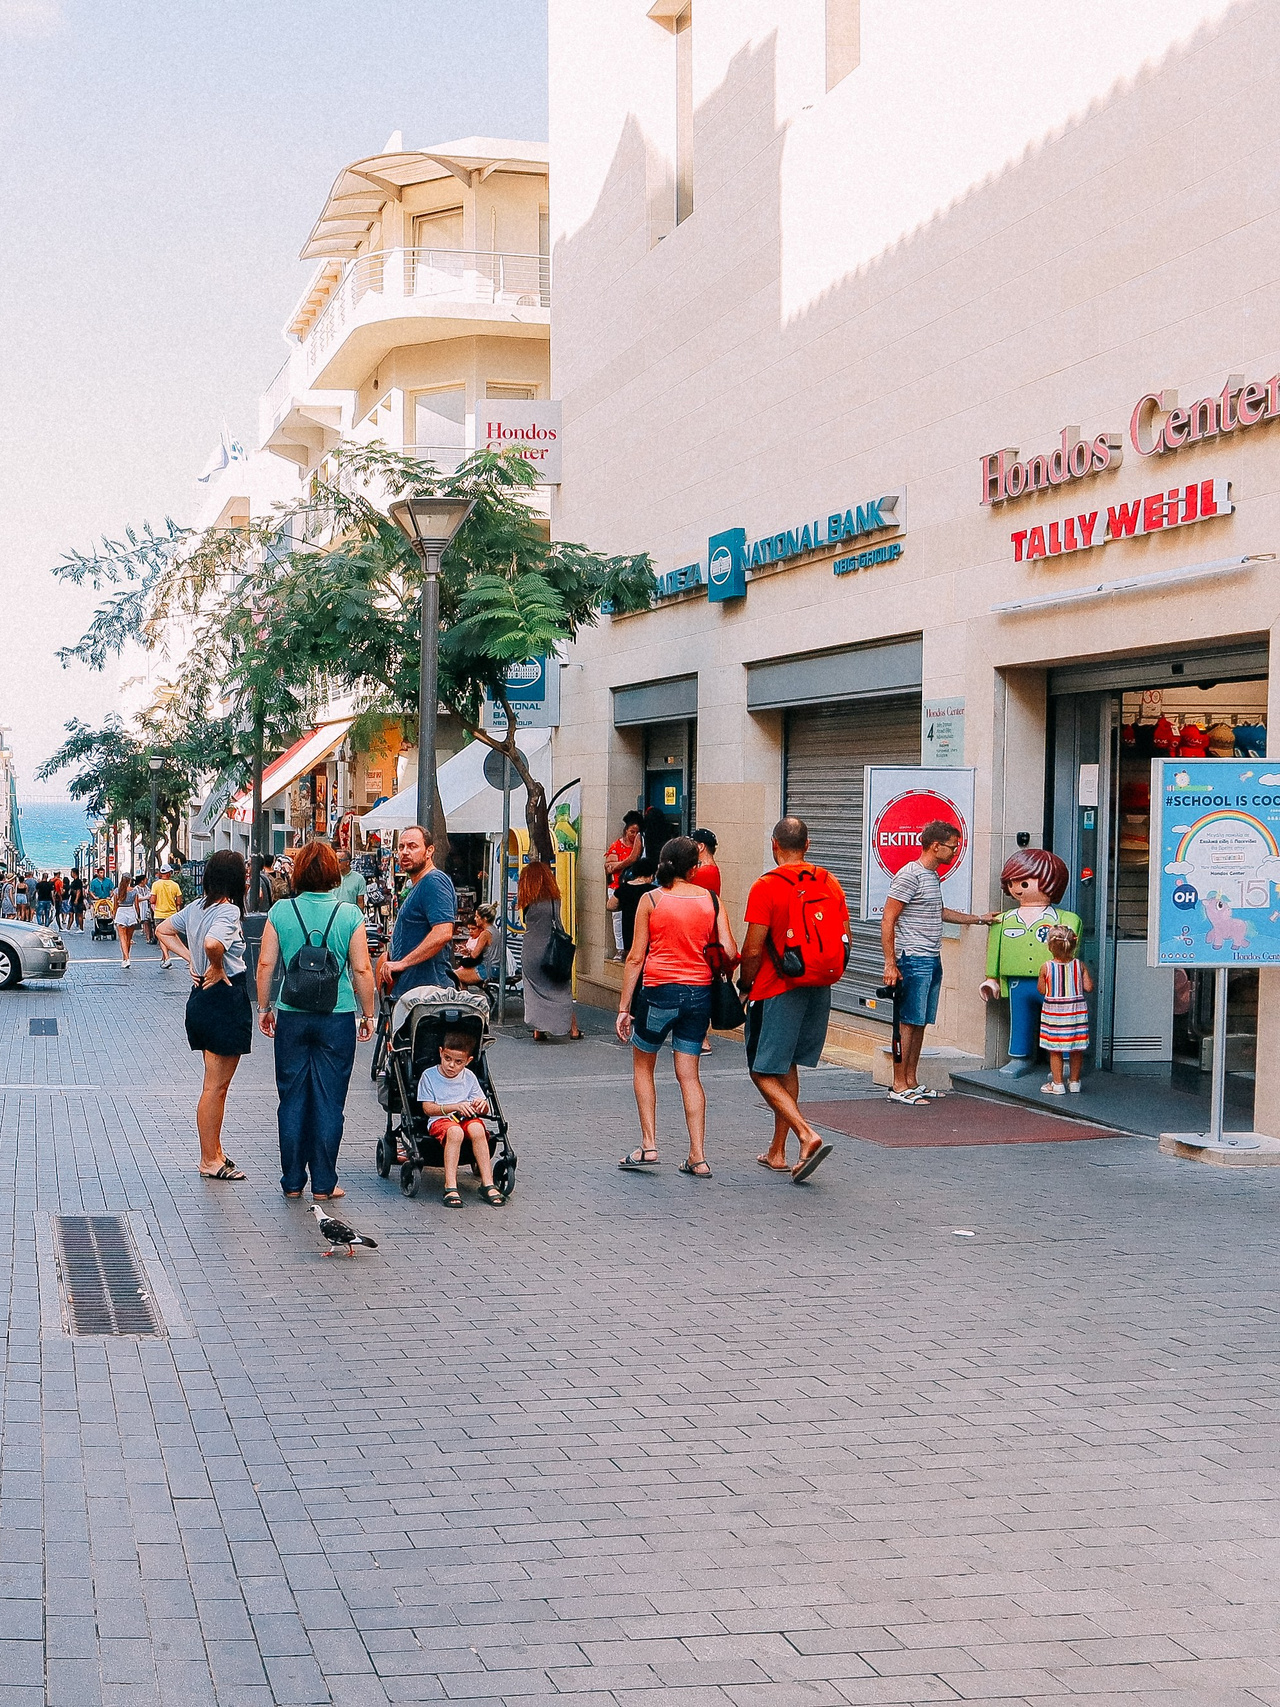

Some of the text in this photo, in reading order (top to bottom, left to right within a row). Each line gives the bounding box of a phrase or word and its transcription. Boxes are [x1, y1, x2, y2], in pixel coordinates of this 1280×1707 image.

[485, 422, 557, 440] Hondos
[980, 424, 1115, 507] Hondos
[741, 496, 888, 571] NATIONAL BANK
[1010, 510, 1099, 563] TALLY
[833, 543, 904, 577] NBG GROUP
[493, 711, 520, 719] BAK
[947, 706, 965, 716] Center
[927, 723, 934, 741] 4
[1166, 795, 1232, 807] #SCHOOL
[1236, 795, 1248, 806] IS
[1174, 891, 1196, 903] OH
[1233, 951, 1261, 961] Hondos
